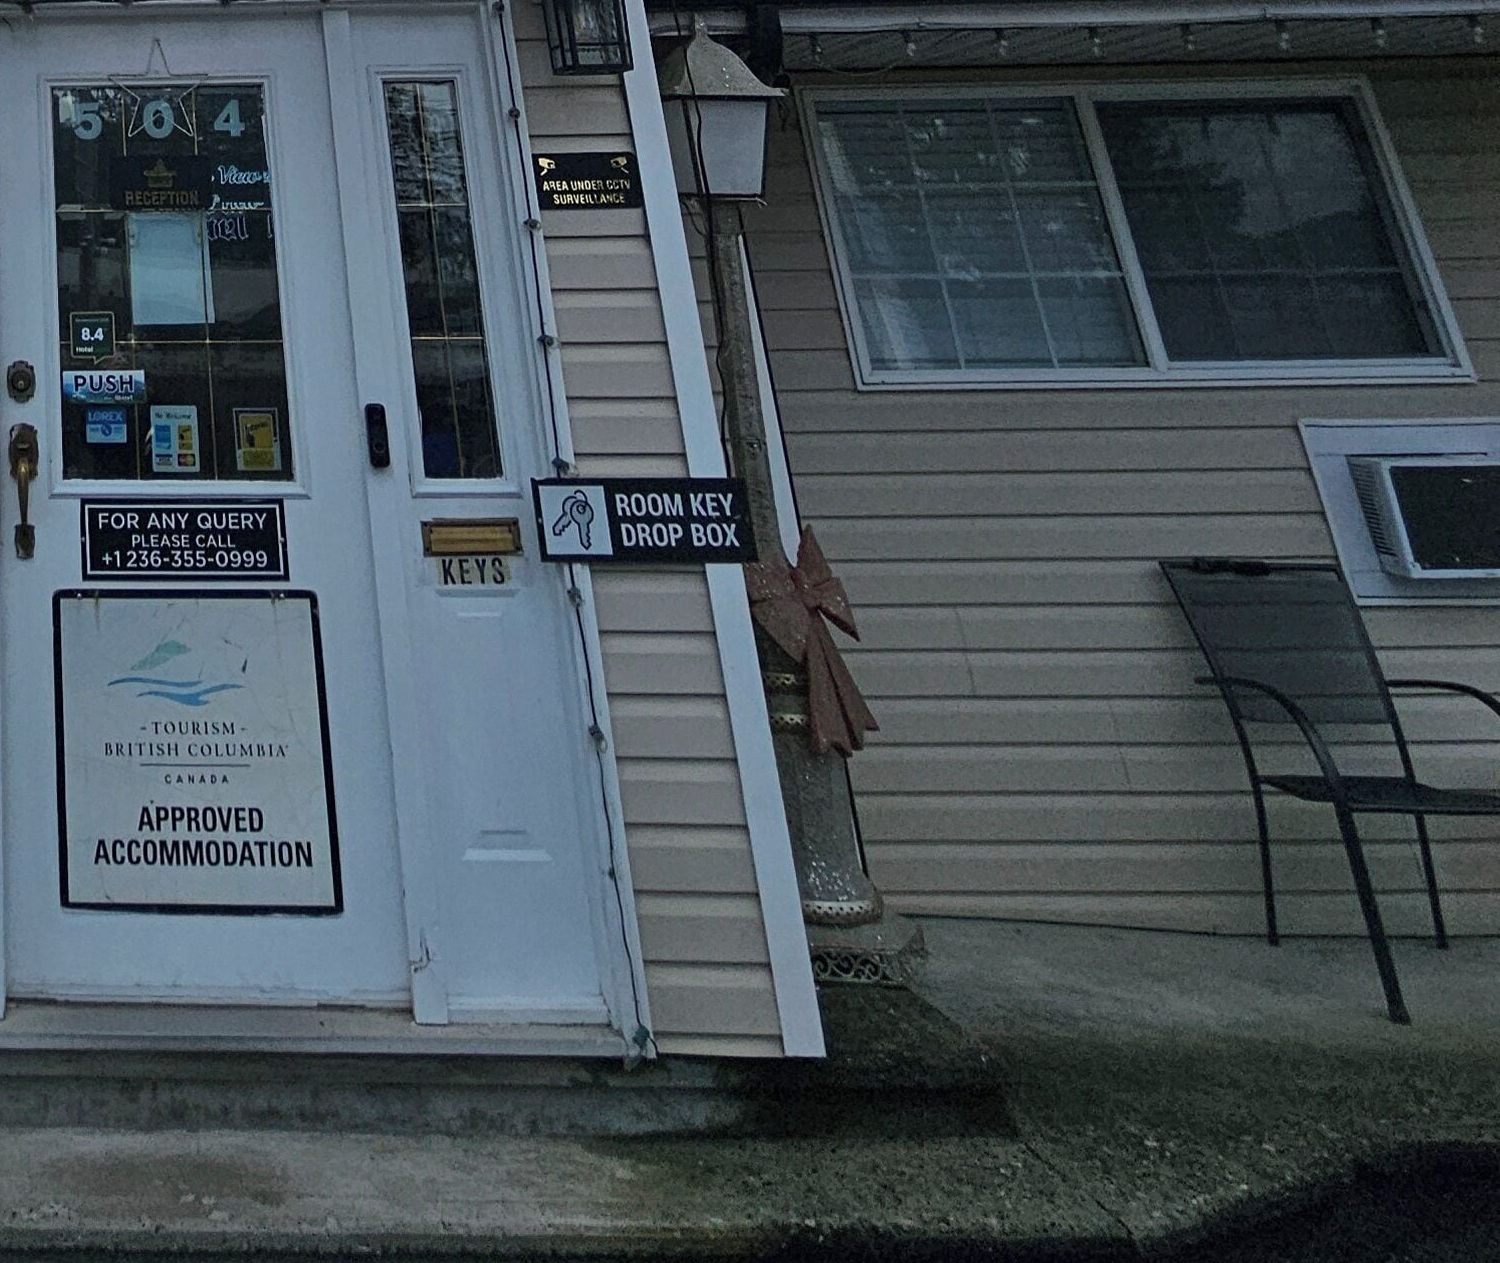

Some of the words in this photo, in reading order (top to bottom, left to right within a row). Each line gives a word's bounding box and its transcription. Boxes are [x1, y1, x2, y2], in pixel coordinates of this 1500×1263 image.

[543, 180, 569, 191] AREA
[570, 180, 604, 191] UNDER
[606, 179, 631, 190] CCTV
[124, 190, 199, 206] RECEPTION
[553, 193, 626, 205] SURVEILLANCE
[81, 327, 104, 342] 8.4
[73, 374, 134, 394] PUSH
[88, 411, 123, 422] LOREX
[614, 492, 685, 518] ROOM
[691, 492, 734, 518] KEY
[98, 513, 139, 529] FOR
[147, 513, 189, 529] ANY
[197, 513, 267, 530] QUERY
[131, 534, 190, 548] PLEASE
[195, 534, 236, 548] CALL
[619, 522, 684, 548] DROP
[690, 522, 741, 548] BOX
[441, 557, 505, 585] KEYS
[104, 742, 179, 757] BRITISH
[187, 743, 287, 758] COLUMBIA
[164, 773, 229, 784] CANADA
[138, 805, 264, 833] APPROVED
[94, 838, 313, 867] ACCOMMODATION
